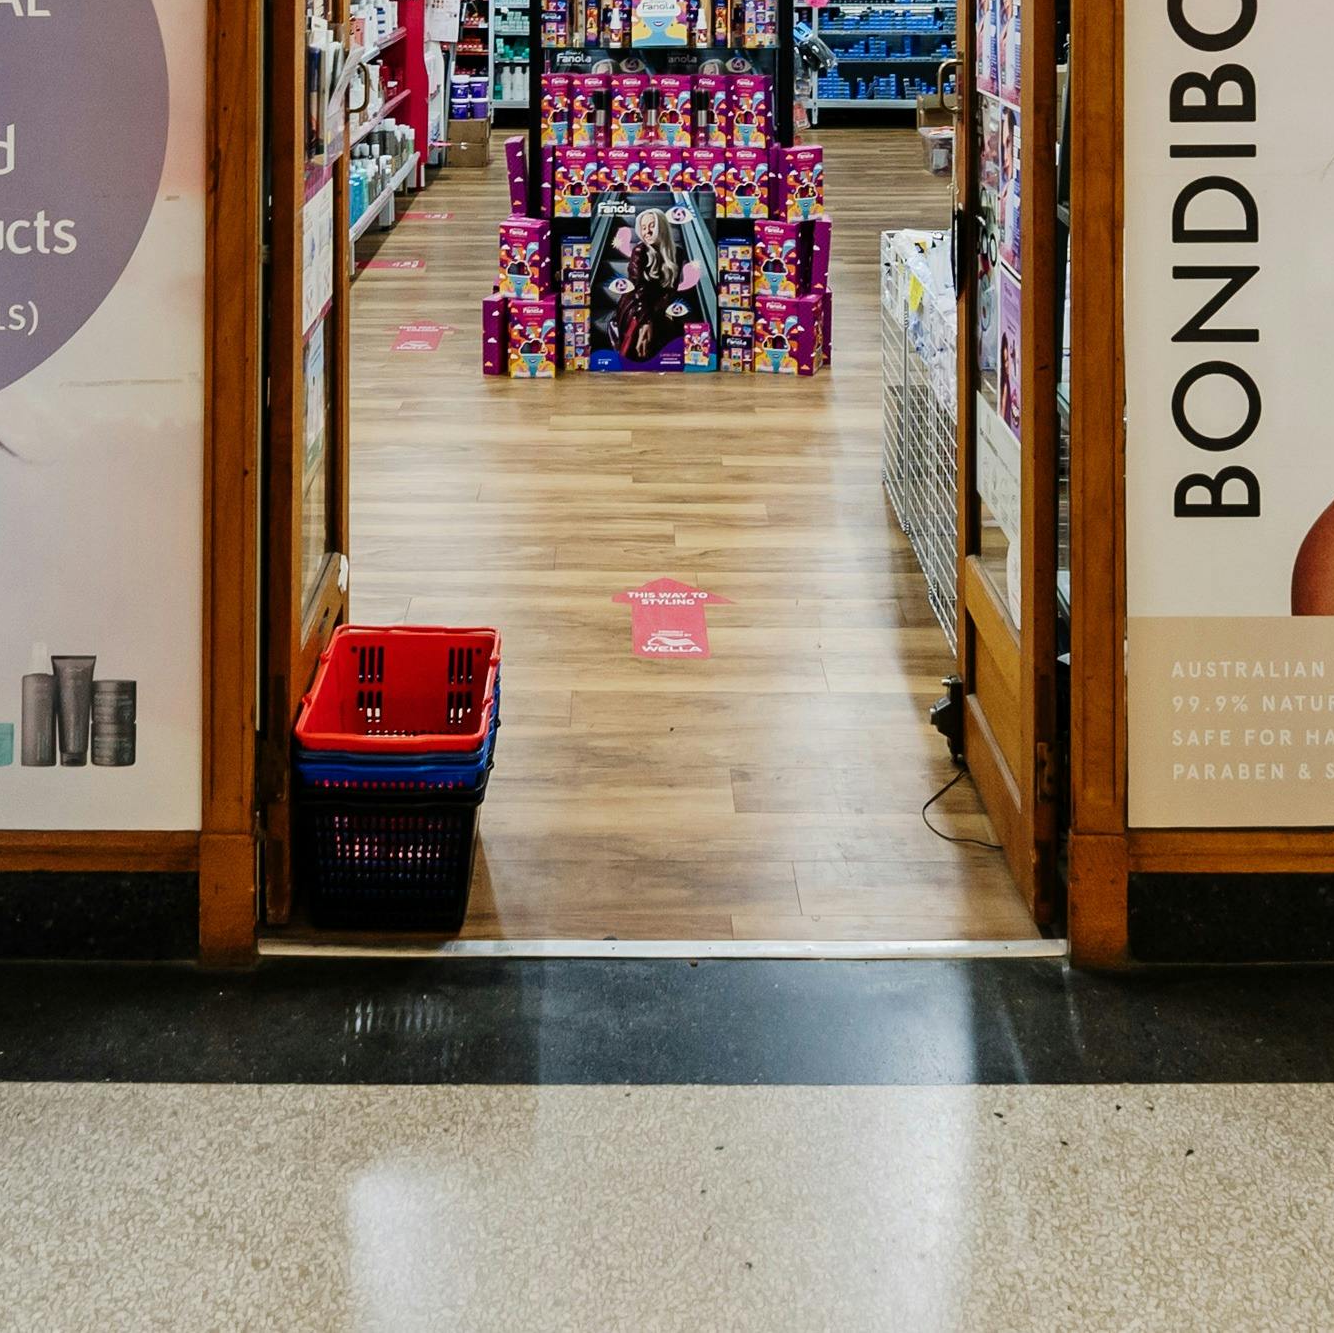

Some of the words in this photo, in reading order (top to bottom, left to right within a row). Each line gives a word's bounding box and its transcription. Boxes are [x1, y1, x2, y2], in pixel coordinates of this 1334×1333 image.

[642, 2, 675, 10] Fanola
[556, 53, 592, 63] Fanola
[598, 202, 636, 214] Fanola
[1171, 661, 1326, 678] AUSTRALIAN
[1172, 695, 1249, 713] 99.9%
[1172, 729, 1232, 746] SAFE
[1244, 729, 1293, 746] FOR
[1172, 763, 1285, 780] PARABEN
[1298, 763, 1312, 779] &
